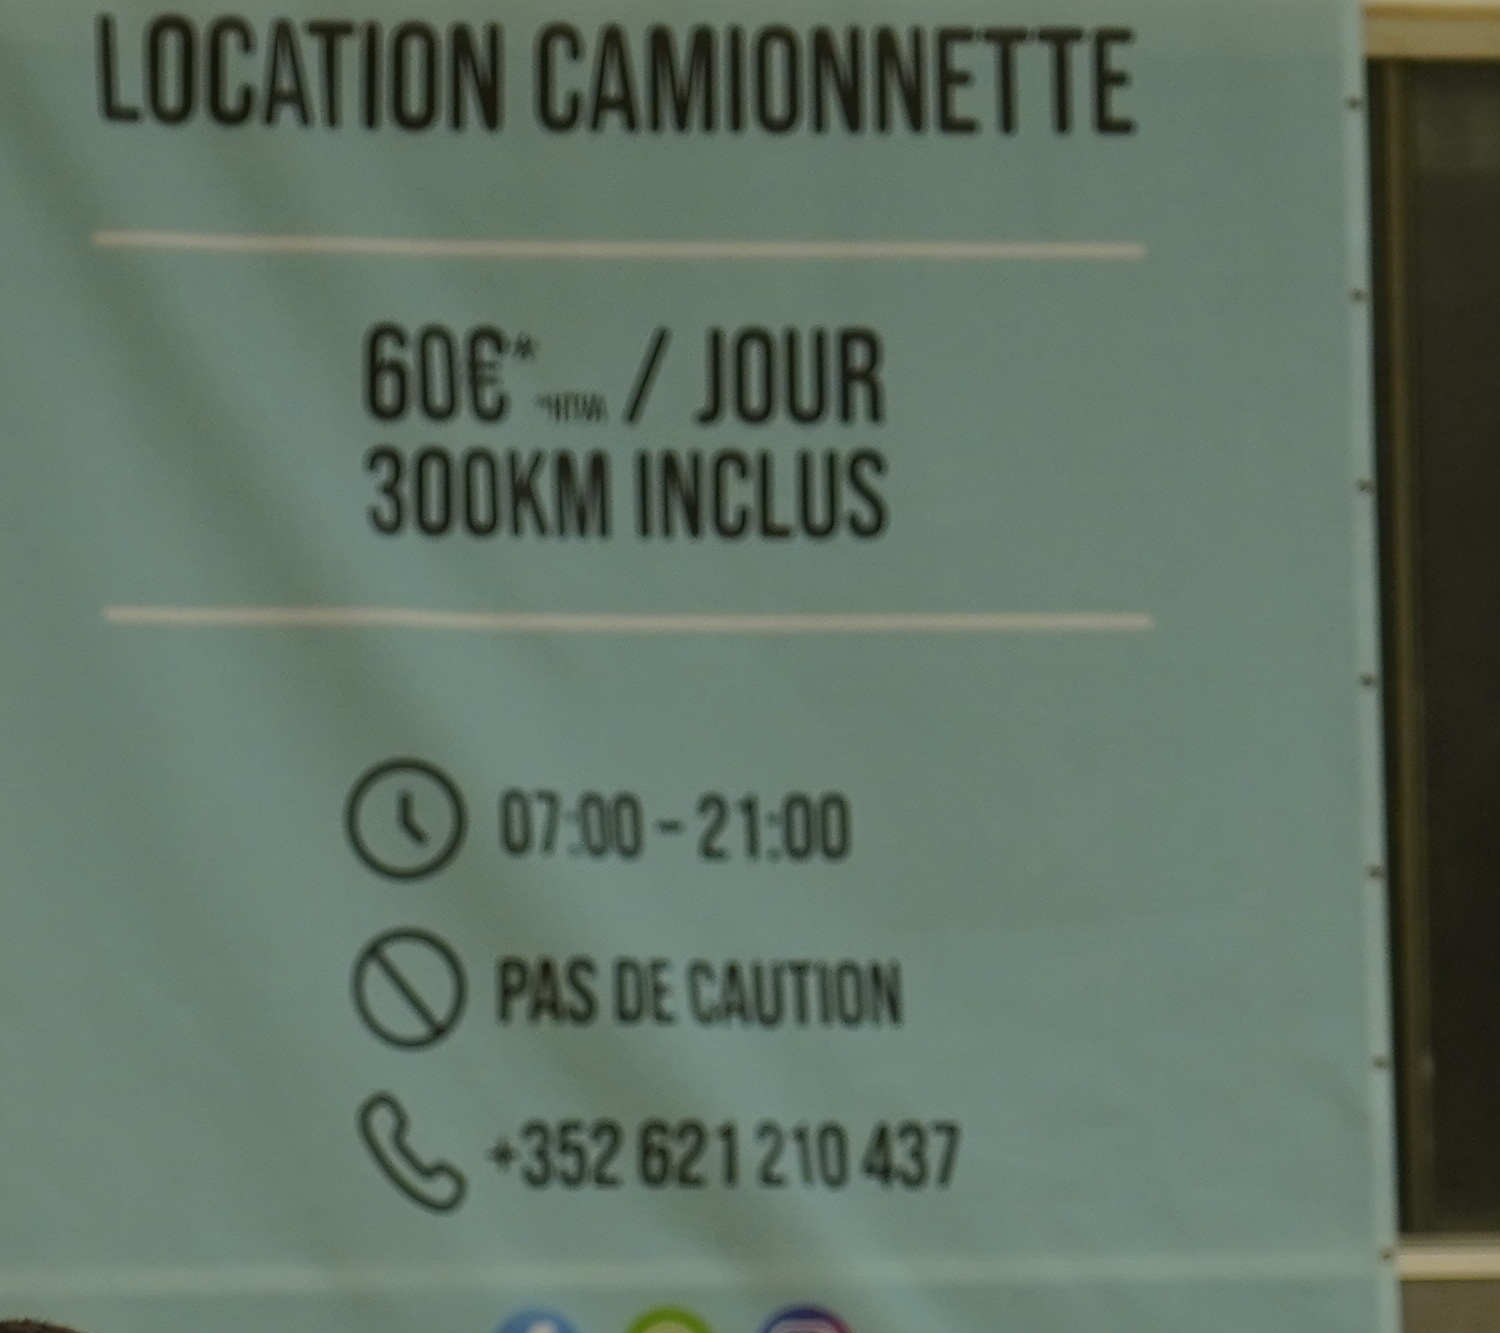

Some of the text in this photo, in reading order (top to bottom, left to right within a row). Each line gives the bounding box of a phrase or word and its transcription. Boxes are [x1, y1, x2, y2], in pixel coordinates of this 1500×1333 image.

[98, 15, 1134, 135] LOCATION CAMIONNETTE
[694, 325, 886, 425] JOUR
[366, 447, 890, 540] 300KM INCLUS
[500, 789, 644, 860] 07:00
[697, 792, 852, 863] 21:00
[495, 956, 905, 1029] PAS DE CAUTION
[487, 1119, 961, 1191] +352 621 210 437
